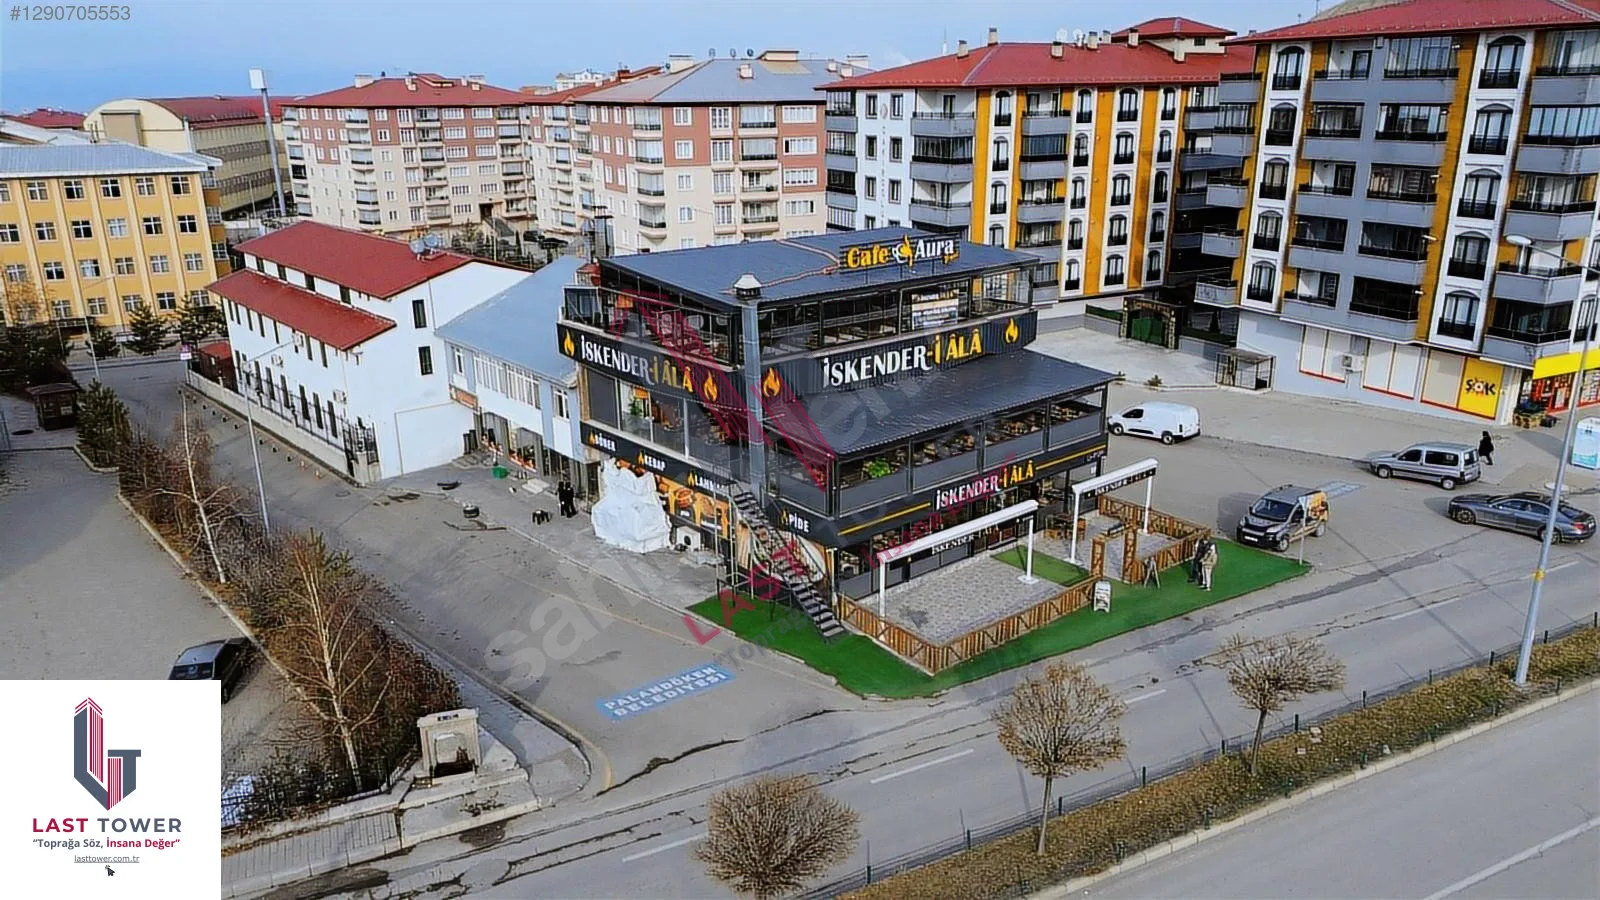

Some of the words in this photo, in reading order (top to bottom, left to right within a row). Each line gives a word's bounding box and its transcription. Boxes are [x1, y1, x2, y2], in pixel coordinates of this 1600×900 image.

[847, 244, 888, 269] Cafe
[914, 239, 955, 259] Aura
[945, 327, 983, 361] ÂLÂ
[788, 512, 810, 534] PİDE
